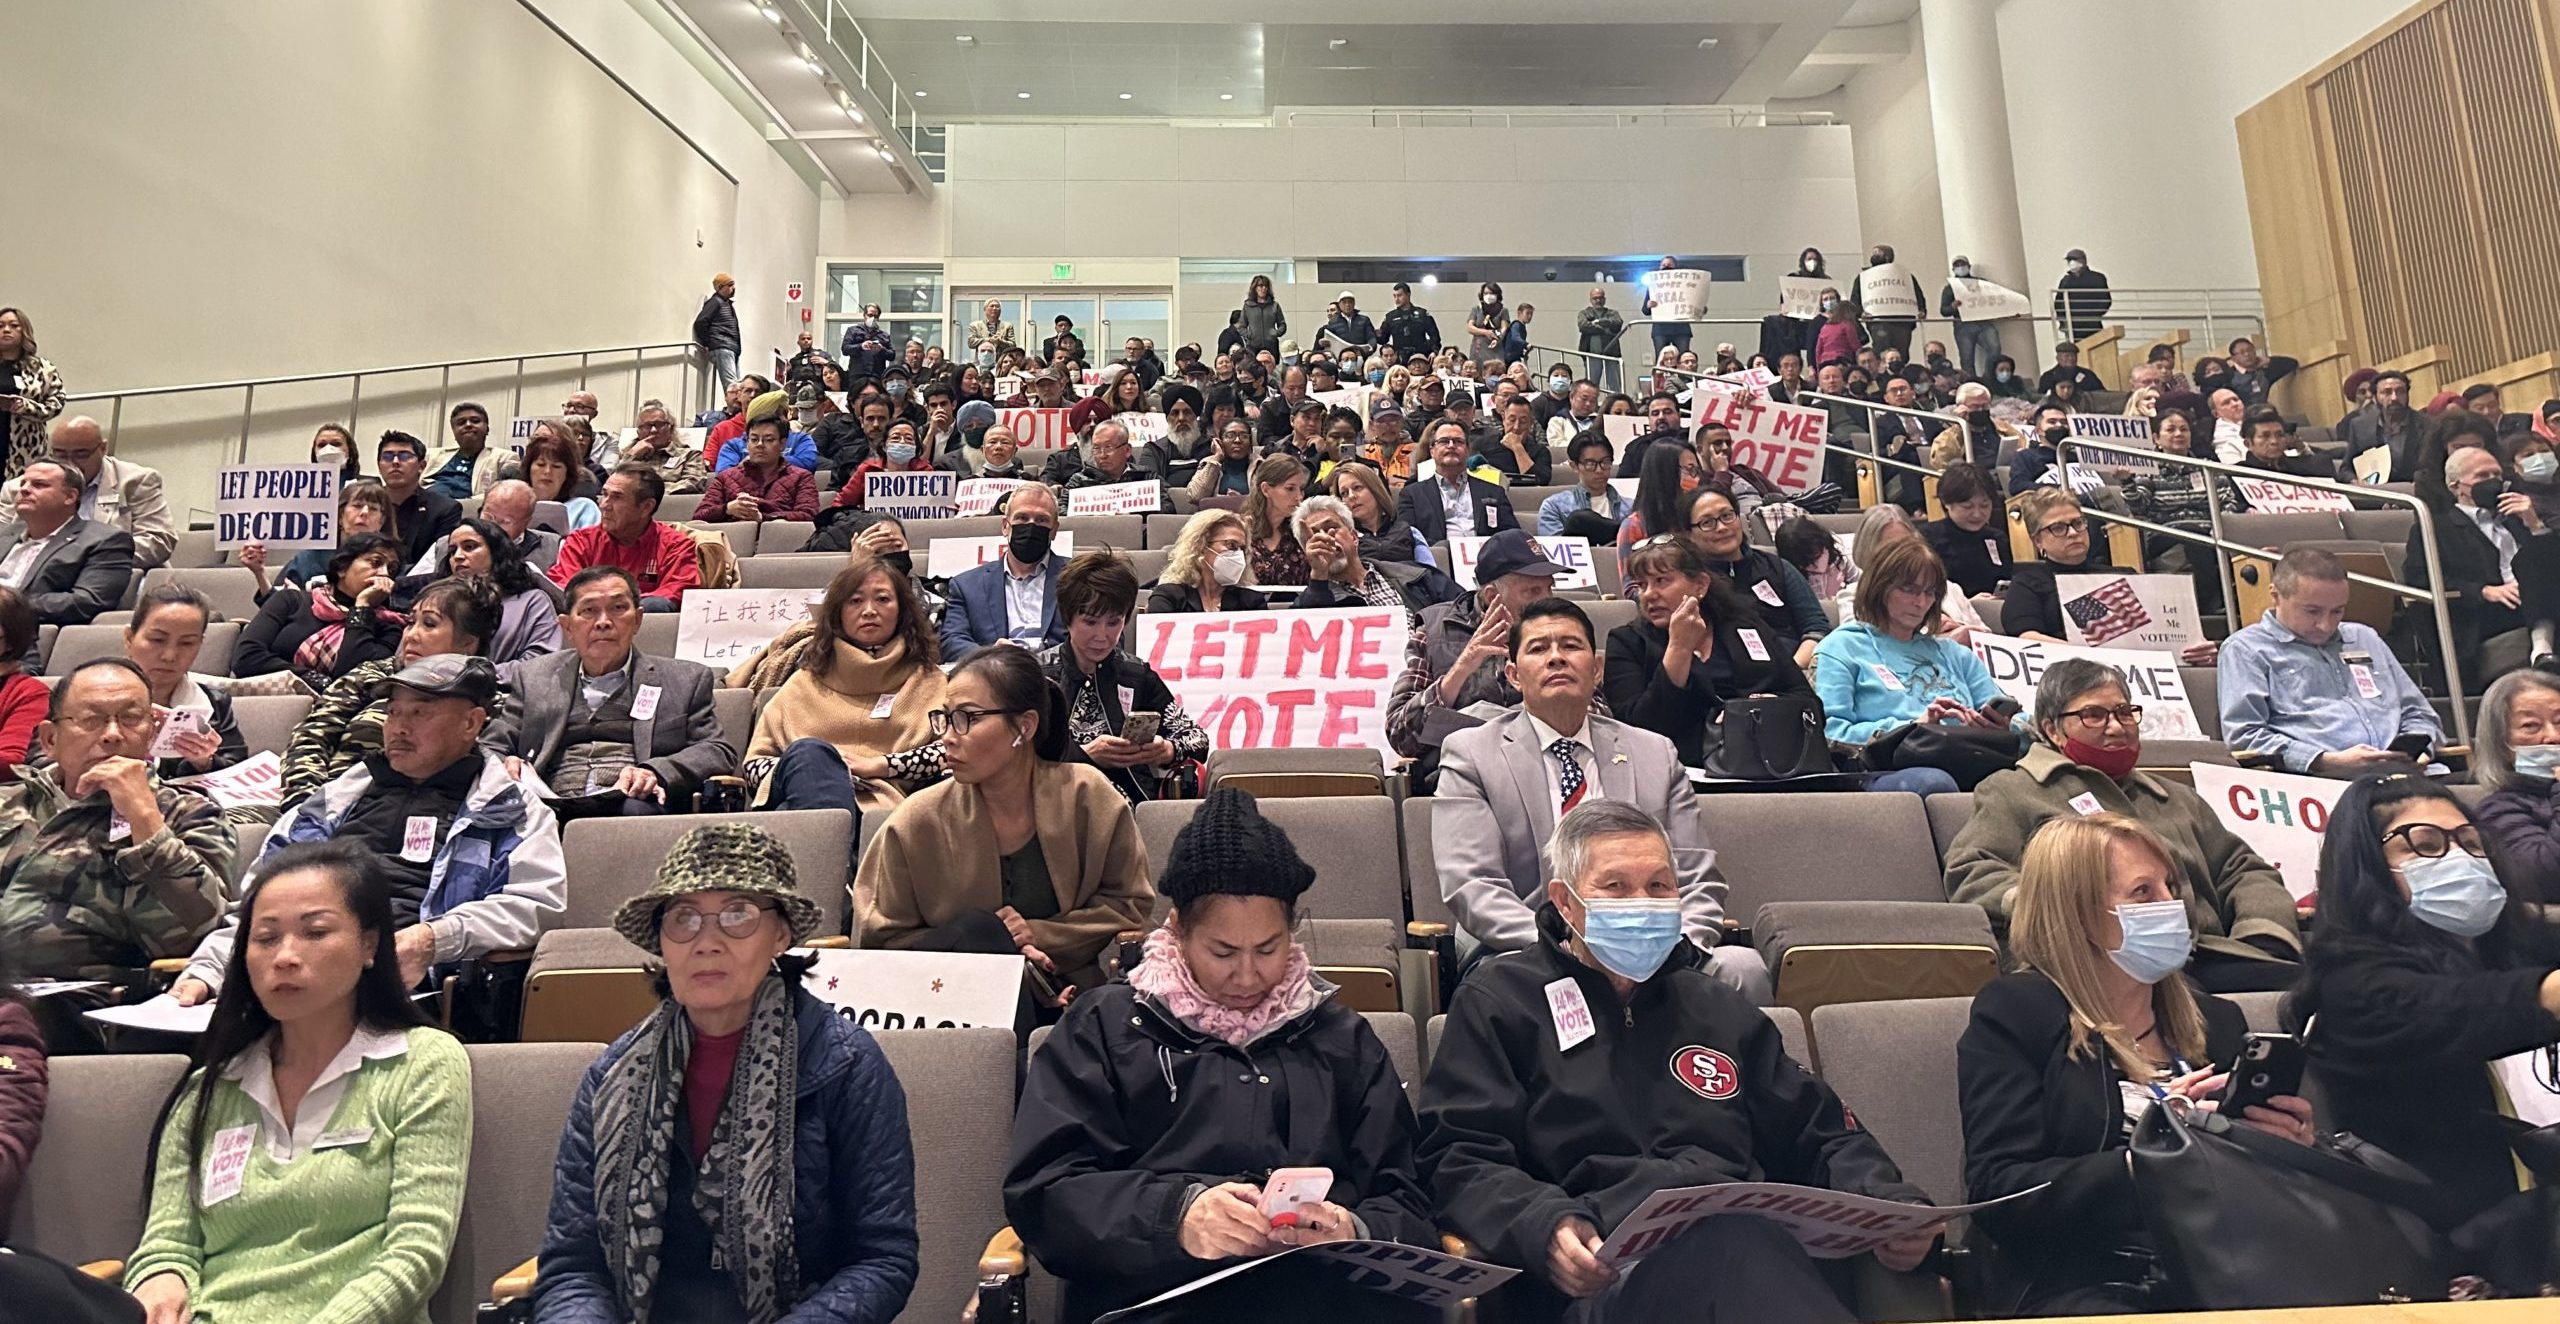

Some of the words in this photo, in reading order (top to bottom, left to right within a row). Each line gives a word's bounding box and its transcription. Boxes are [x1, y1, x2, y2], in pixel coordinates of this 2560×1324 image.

[1700, 397, 1767, 437] LET
[1772, 409, 1825, 446] ME
[2072, 416, 2149, 440] PROTECT
[1731, 438, 1815, 489] OTE
[220, 471, 250, 500] LET
[253, 469, 331, 499] PEOPLE
[868, 475, 952, 498] PROTECT
[219, 511, 330, 541] DECIDE
[2162, 604, 2178, 615] Let
[2165, 619, 2181, 629] Me
[703, 637, 743, 658] Let
[1150, 618, 1278, 681] LET
[1284, 614, 1392, 680] ME
[406, 837, 432, 851] VOTE
[1556, 1007, 1590, 1032] VOTE
[1692, 1053, 1731, 1093] SF
[211, 1150, 247, 1175] VOTE
